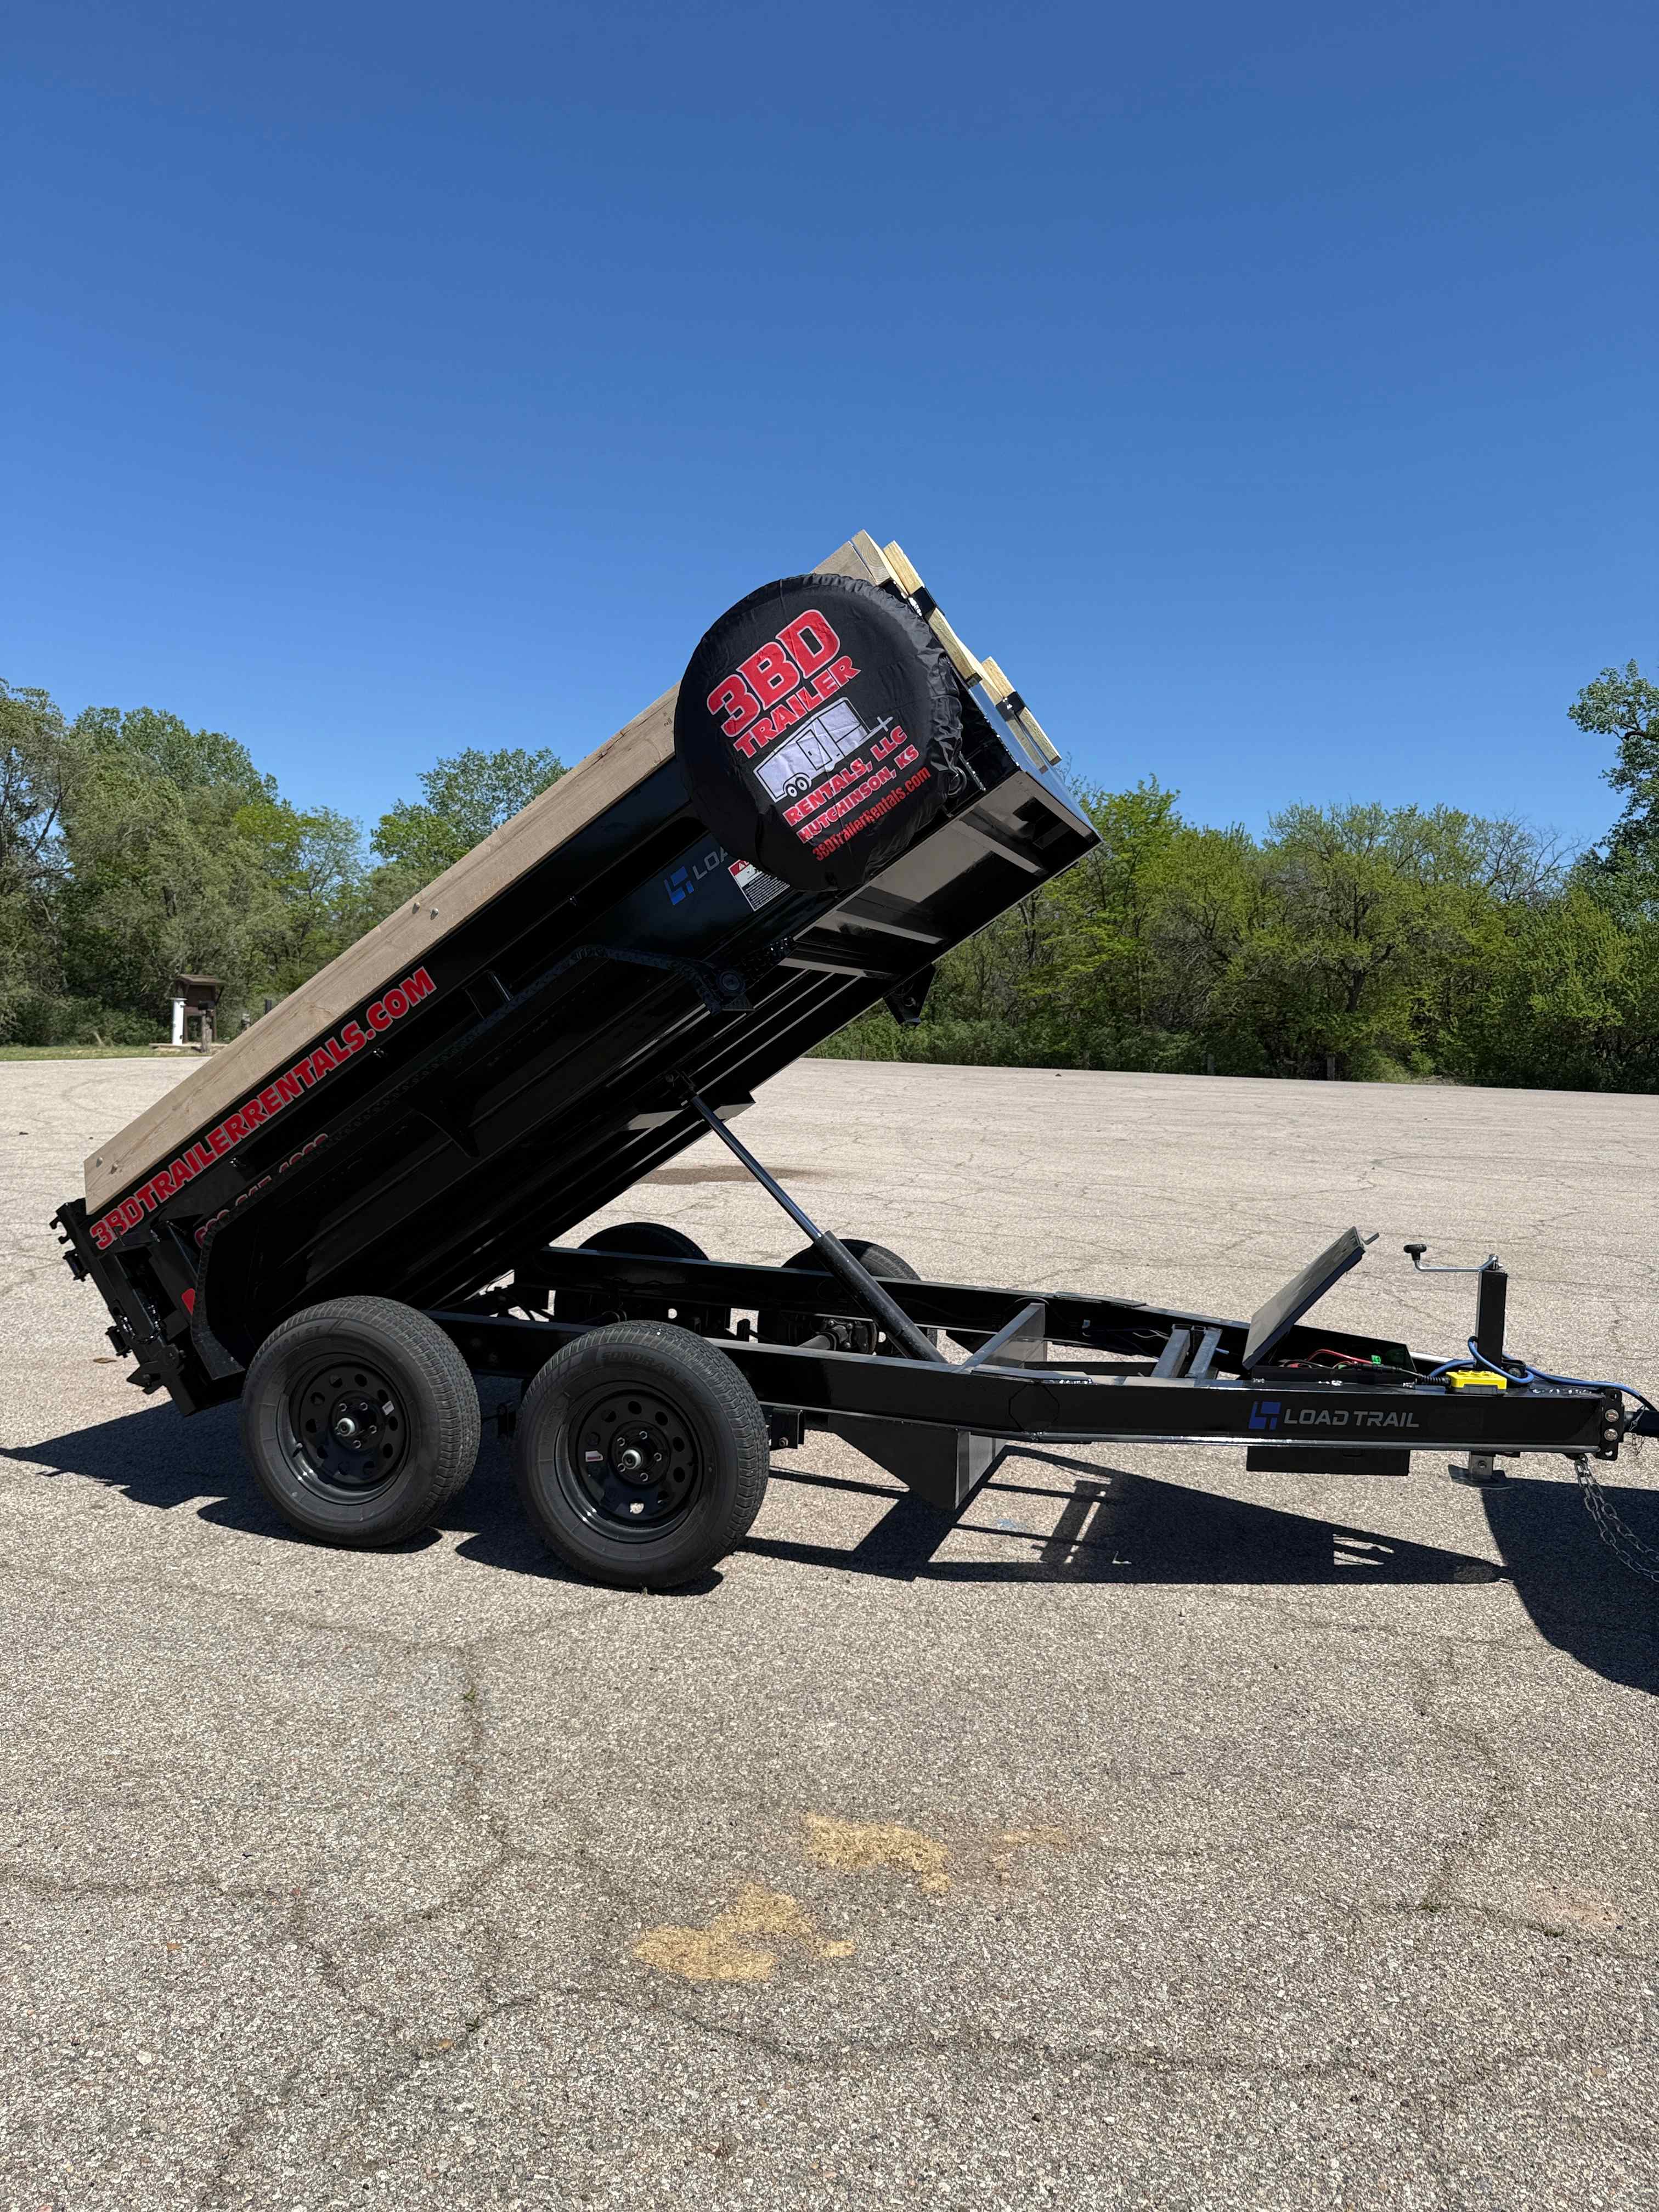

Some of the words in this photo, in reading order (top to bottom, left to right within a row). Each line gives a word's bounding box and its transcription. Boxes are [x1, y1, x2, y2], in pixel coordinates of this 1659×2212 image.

[707, 609, 840, 737] 3BD
[733, 656, 862, 759] TRAILER
[782, 758, 873, 827] RENTALS,
[870, 725, 908, 762] LLC
[796, 766, 897, 844] HUTCHINSON,
[894, 744, 919, 770] KS
[812, 766, 931, 861] 3BDTrailerRentals.com
[692, 846, 729, 881] LOA
[89, 966, 438, 1250] 3BDTRAILERRENTALS.COM
[1284, 1408, 1350, 1426] LOAD
[1353, 1410, 1420, 1428] TRAIL
